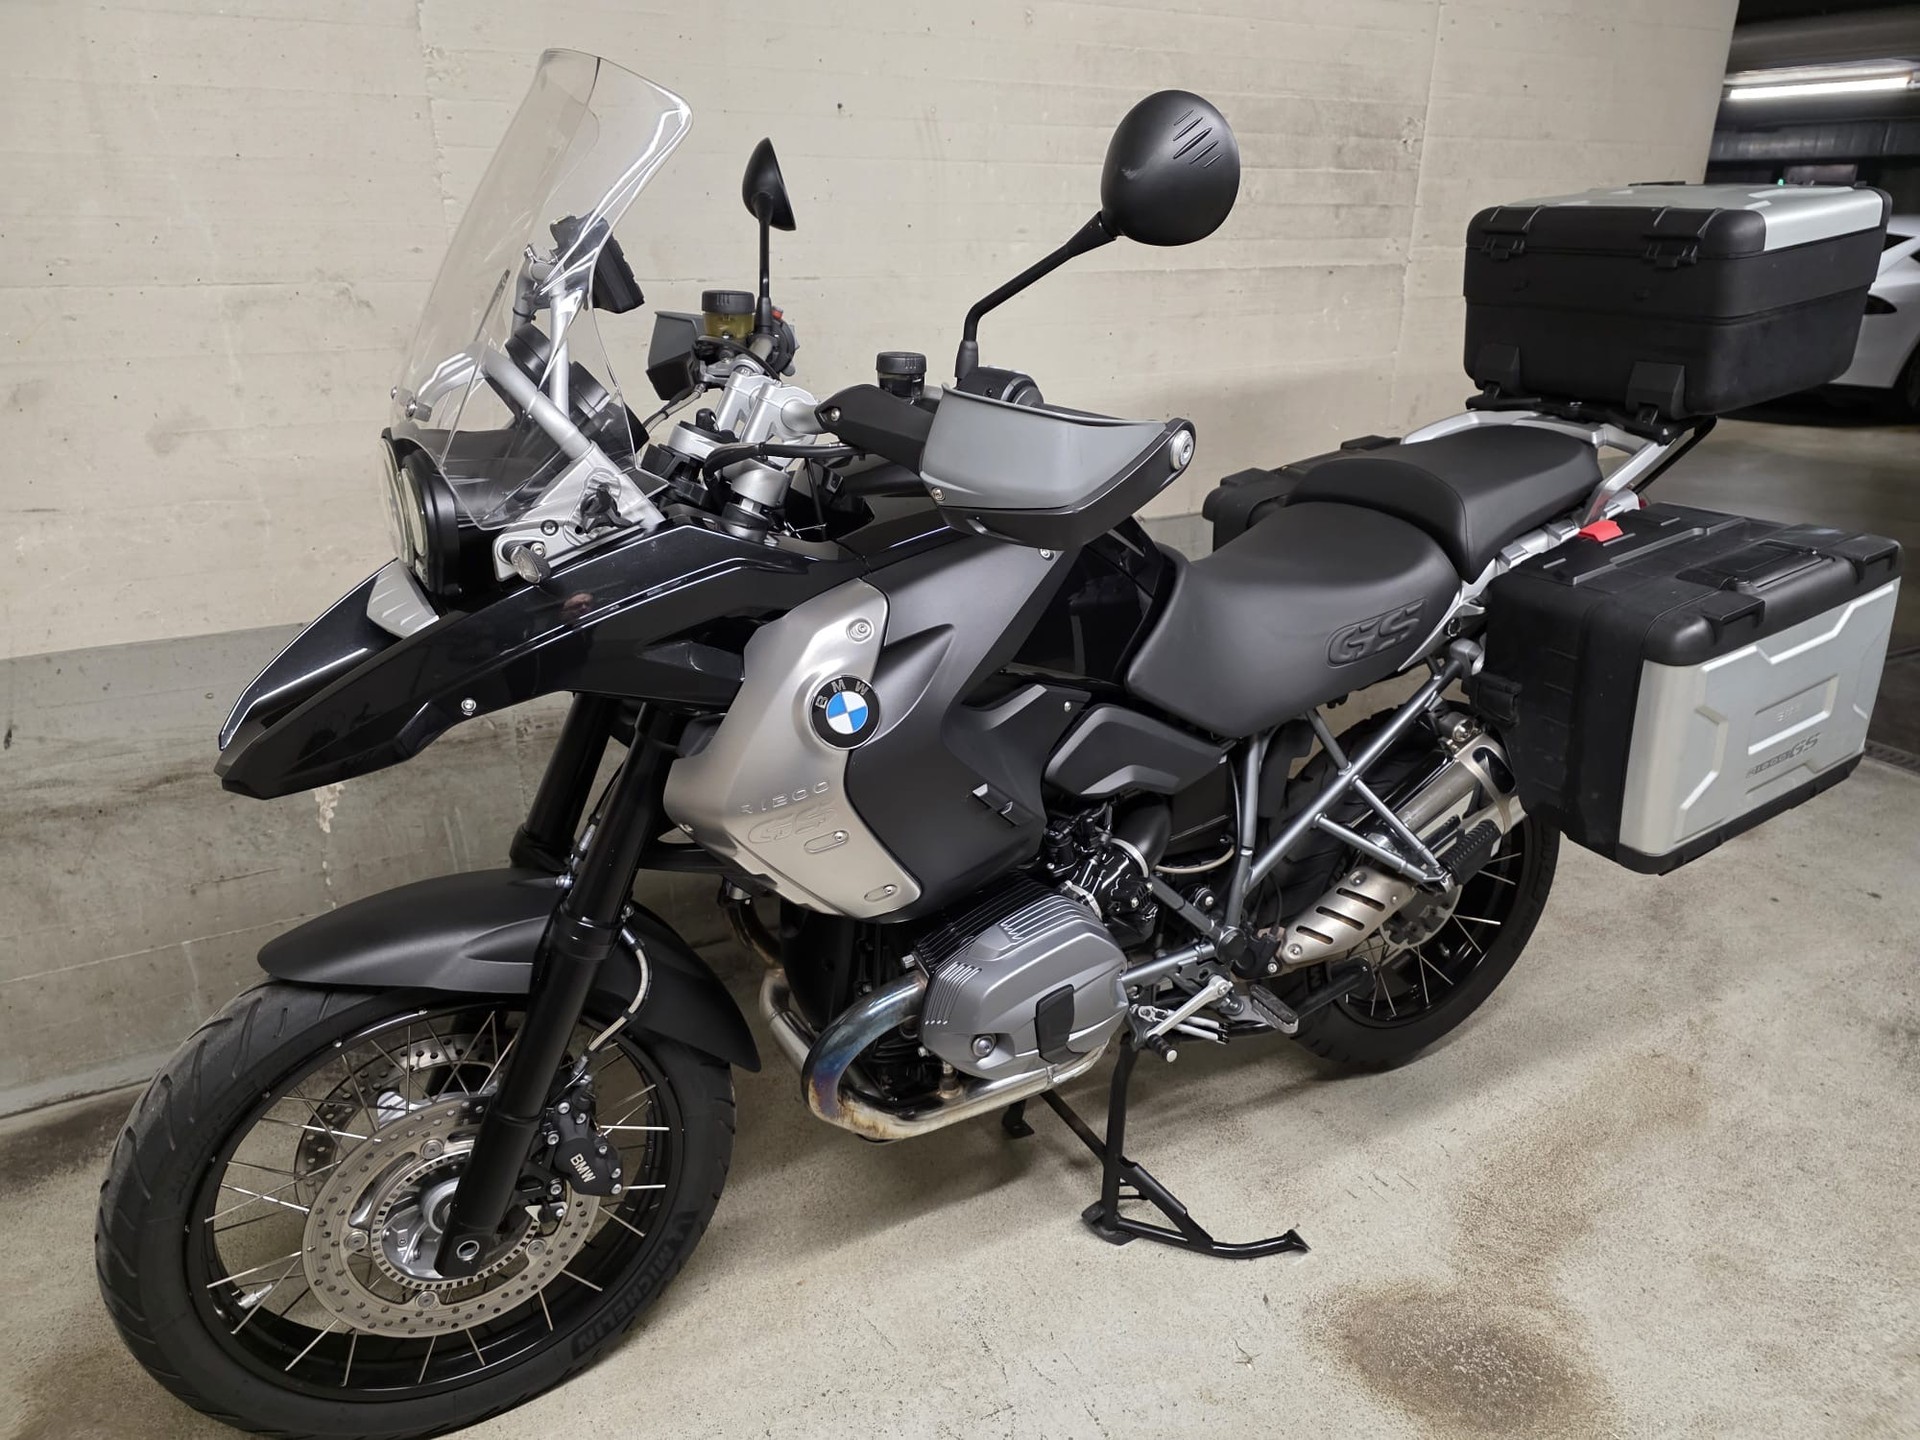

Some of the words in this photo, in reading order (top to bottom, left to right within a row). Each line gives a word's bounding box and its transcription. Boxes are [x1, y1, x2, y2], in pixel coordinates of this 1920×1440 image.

[1328, 600, 1424, 665] GS
[815, 679, 869, 709] BMW
[570, 1153, 596, 1183] BMW
[577, 1245, 677, 1352] MICHELIN
